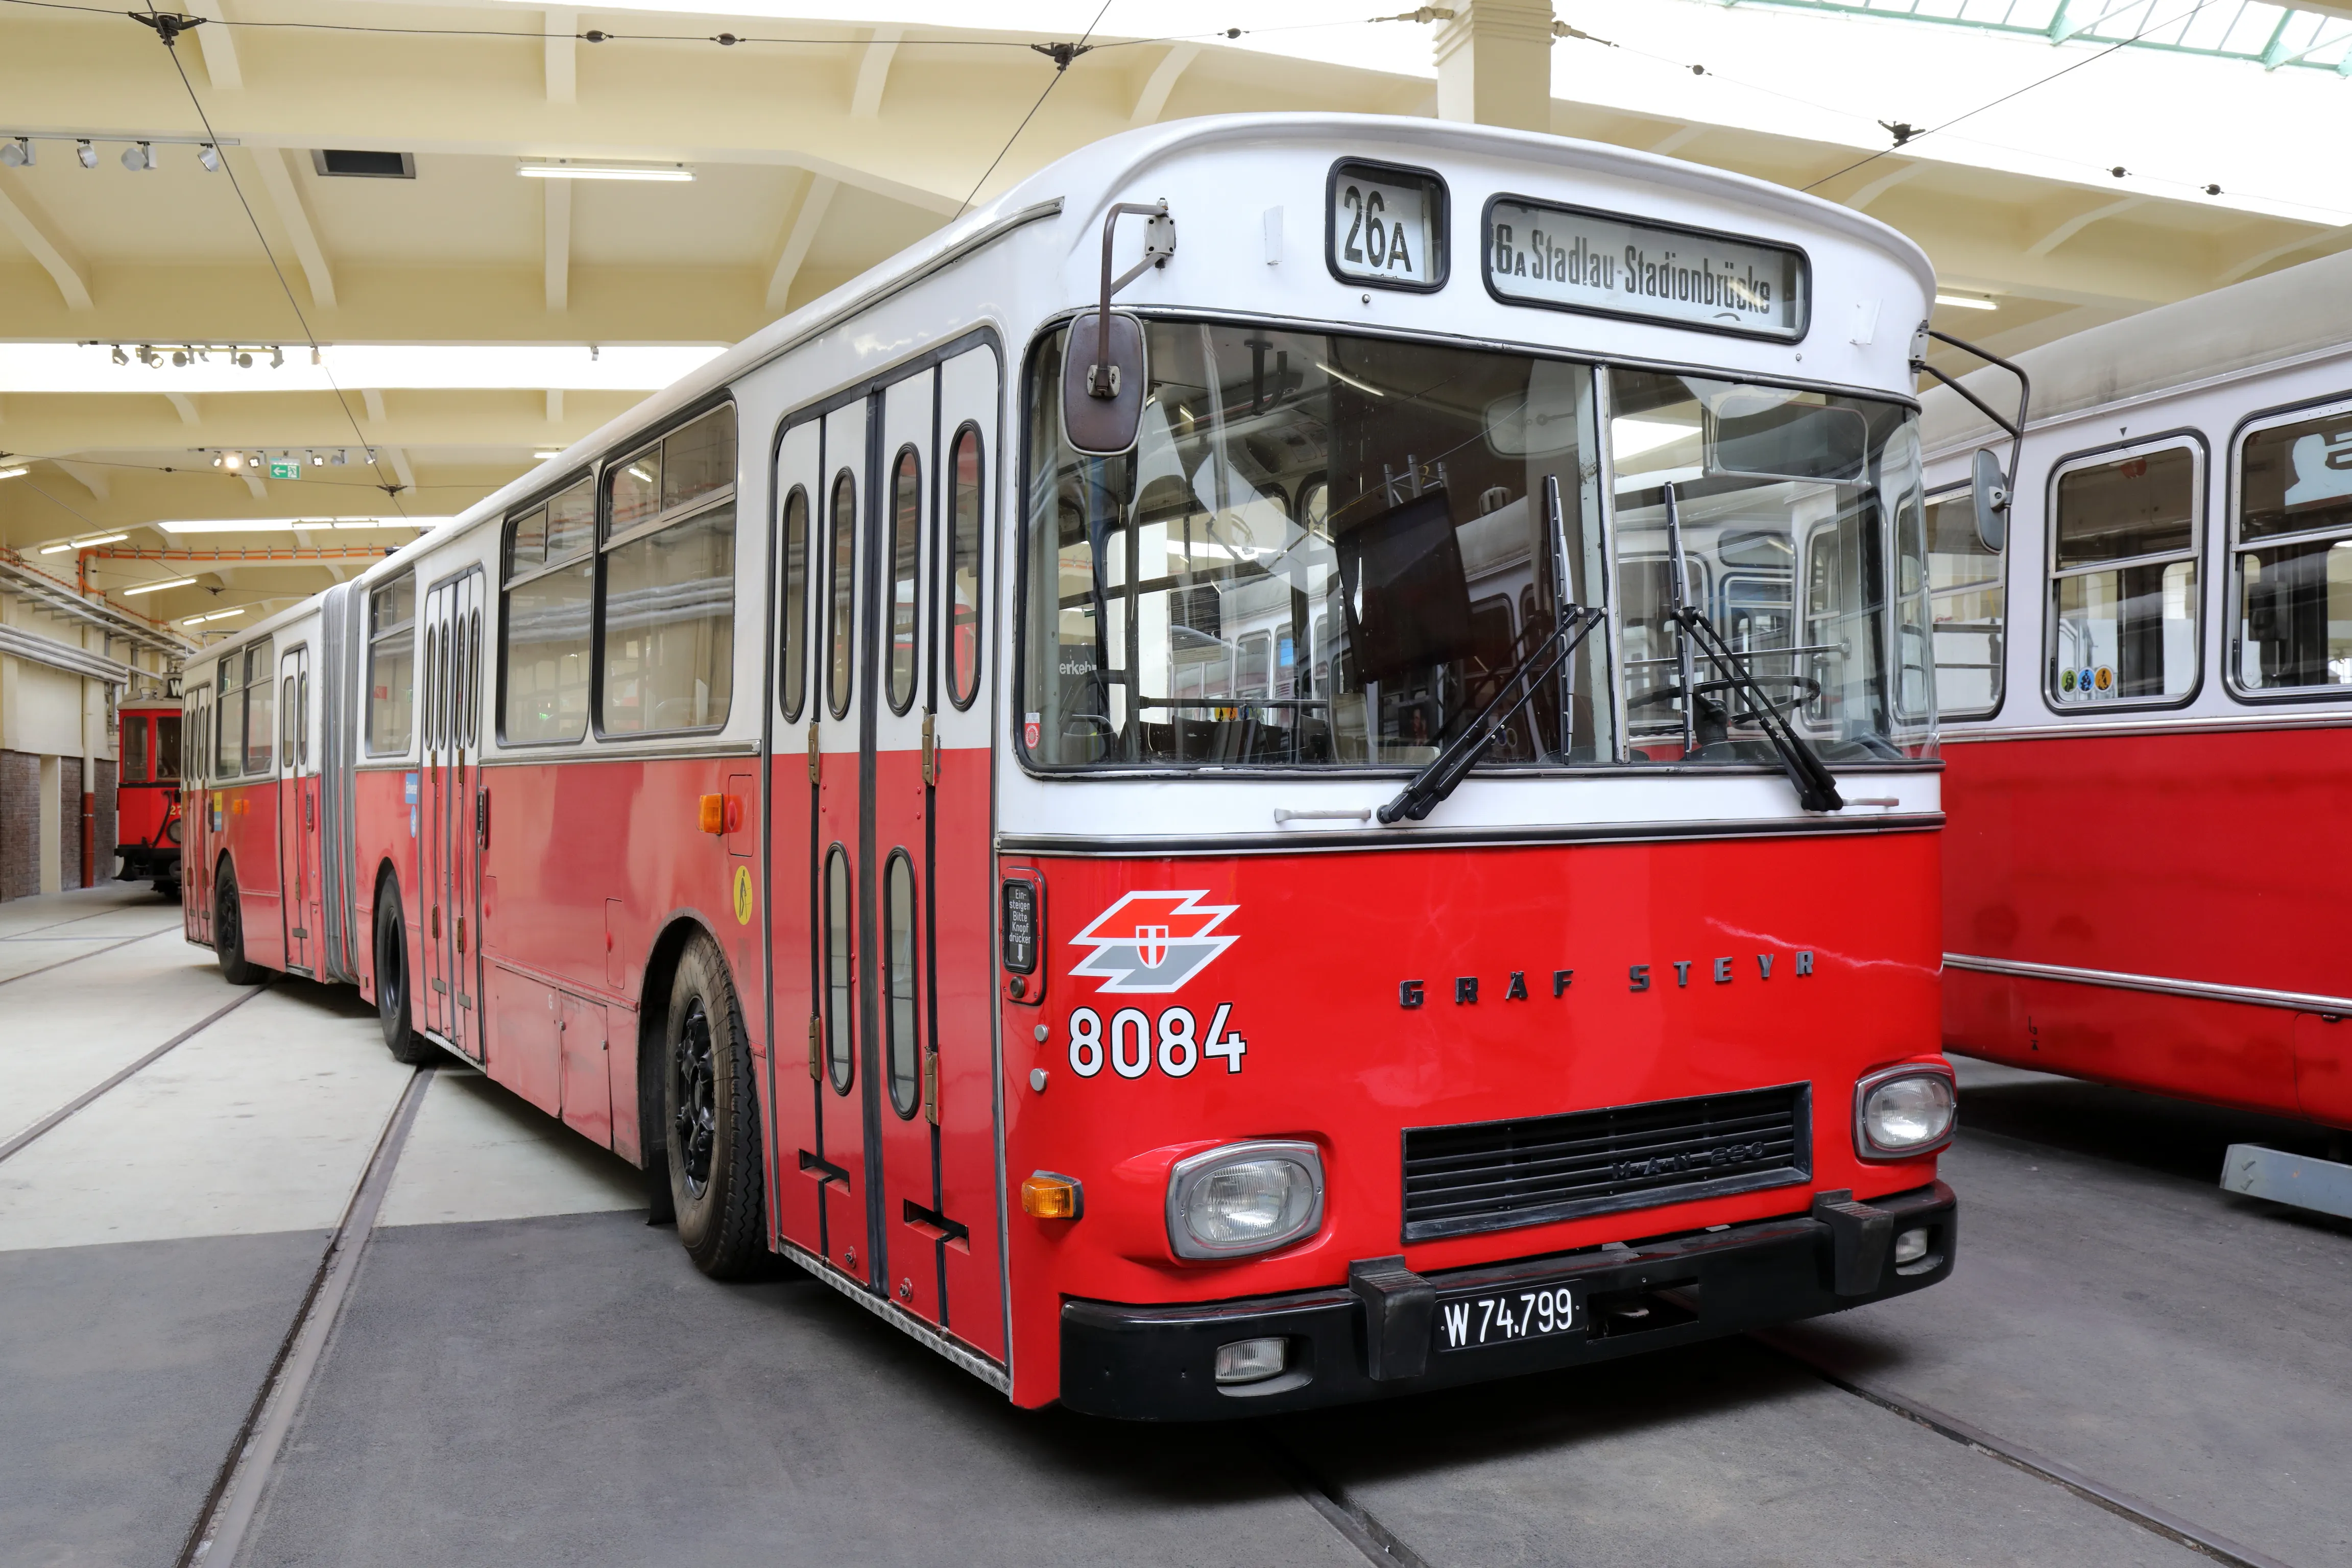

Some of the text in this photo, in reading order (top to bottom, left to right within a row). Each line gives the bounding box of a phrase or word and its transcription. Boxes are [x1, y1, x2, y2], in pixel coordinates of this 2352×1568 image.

[1344, 185, 1412, 272] 26A
[1009, 900, 1030, 912] steigen
[1015, 889, 1026, 900] Ein-
[1012, 922, 1029, 935] Knopf
[1013, 911, 1027, 922] Bitte
[1400, 951, 1814, 1006] GRÄF STEYR
[1068, 1002, 1247, 1079] 8084
[1444, 1288, 1572, 1347] W 74.799
